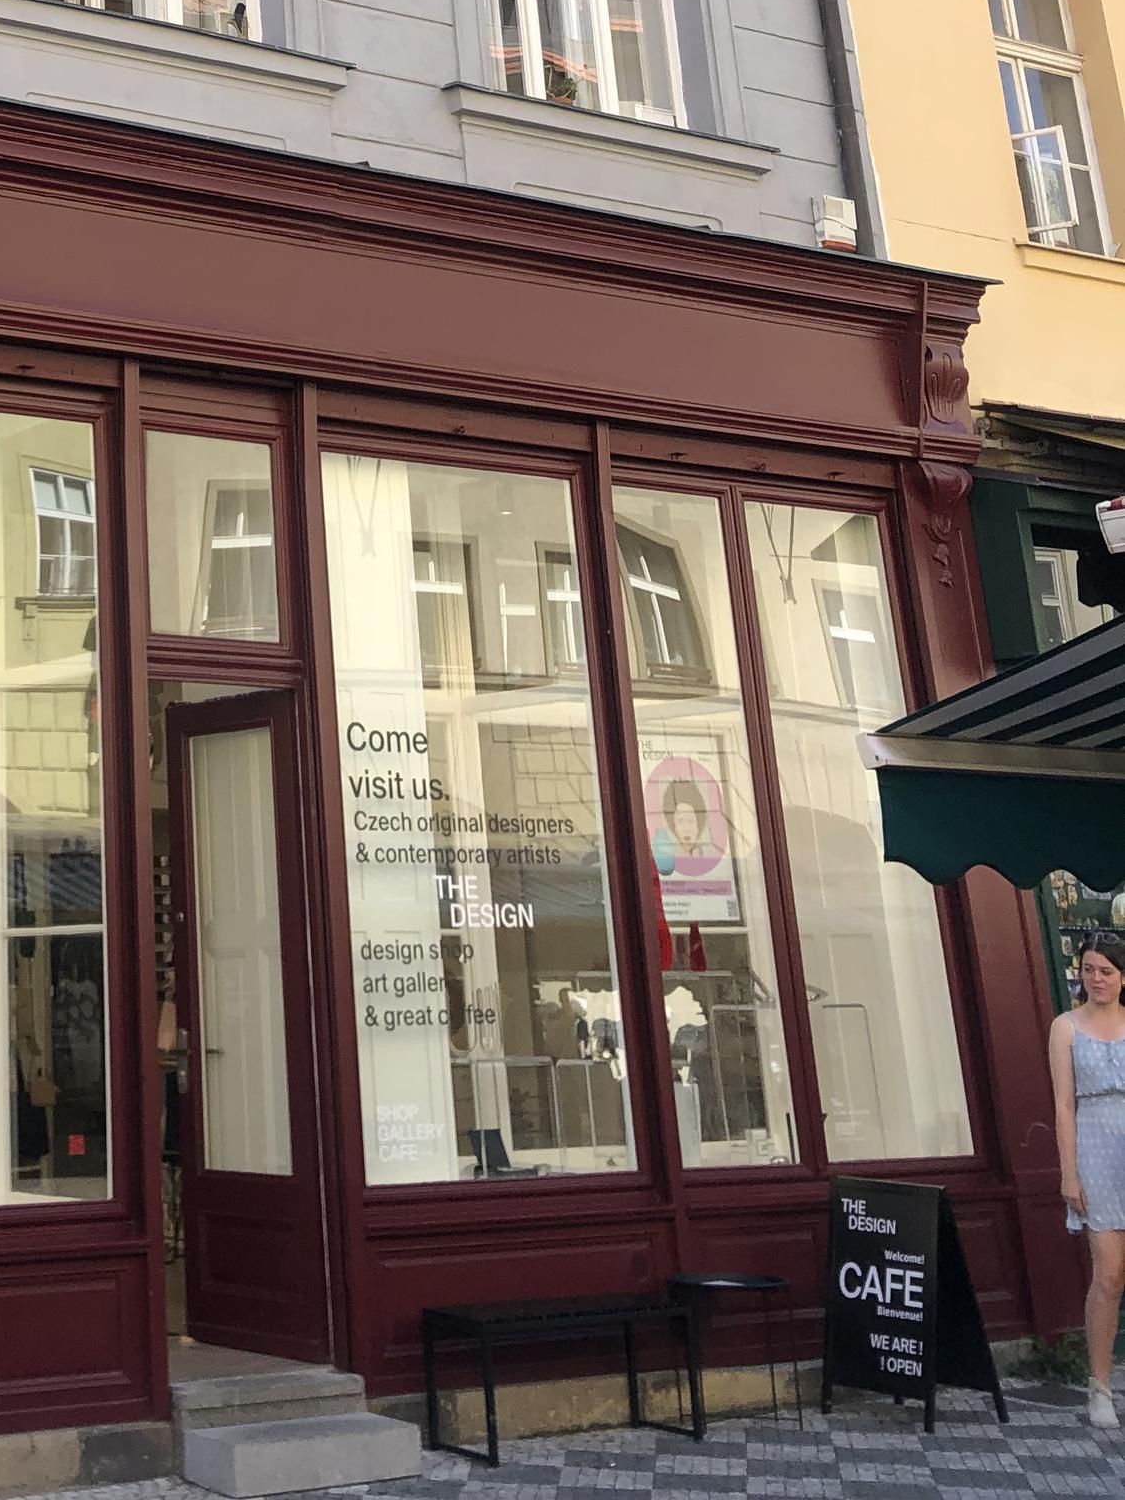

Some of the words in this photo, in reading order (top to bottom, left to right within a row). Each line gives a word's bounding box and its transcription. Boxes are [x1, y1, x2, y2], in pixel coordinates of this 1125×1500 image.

[346, 722, 428, 754] Come
[349, 770, 405, 799] visit
[412, 778, 450, 801] us.
[354, 810, 412, 832] Czech
[417, 812, 484, 837] original
[489, 813, 574, 837] designers
[356, 843, 370, 864] &
[375, 846, 501, 867] contemporary
[507, 845, 561, 864] artists
[433, 875, 478, 899] THE
[450, 903, 534, 928] DESIGN
[360, 939, 424, 965] design
[363, 973, 389, 993] art
[393, 972, 452, 998] galler
[365, 1005, 379, 1027] &
[384, 1006, 434, 1031] great
[377, 1103, 418, 1122] SHOP
[378, 1123, 444, 1142] GALLERY
[379, 1144, 418, 1162] CAFE
[841, 1198, 866, 1215] THE
[848, 1215, 896, 1235] DESIGN
[839, 1261, 924, 1308] CAFE
[870, 1333, 890, 1350] WE
[892, 1337, 917, 1355] ARE
[887, 1357, 922, 1377] OPEN
